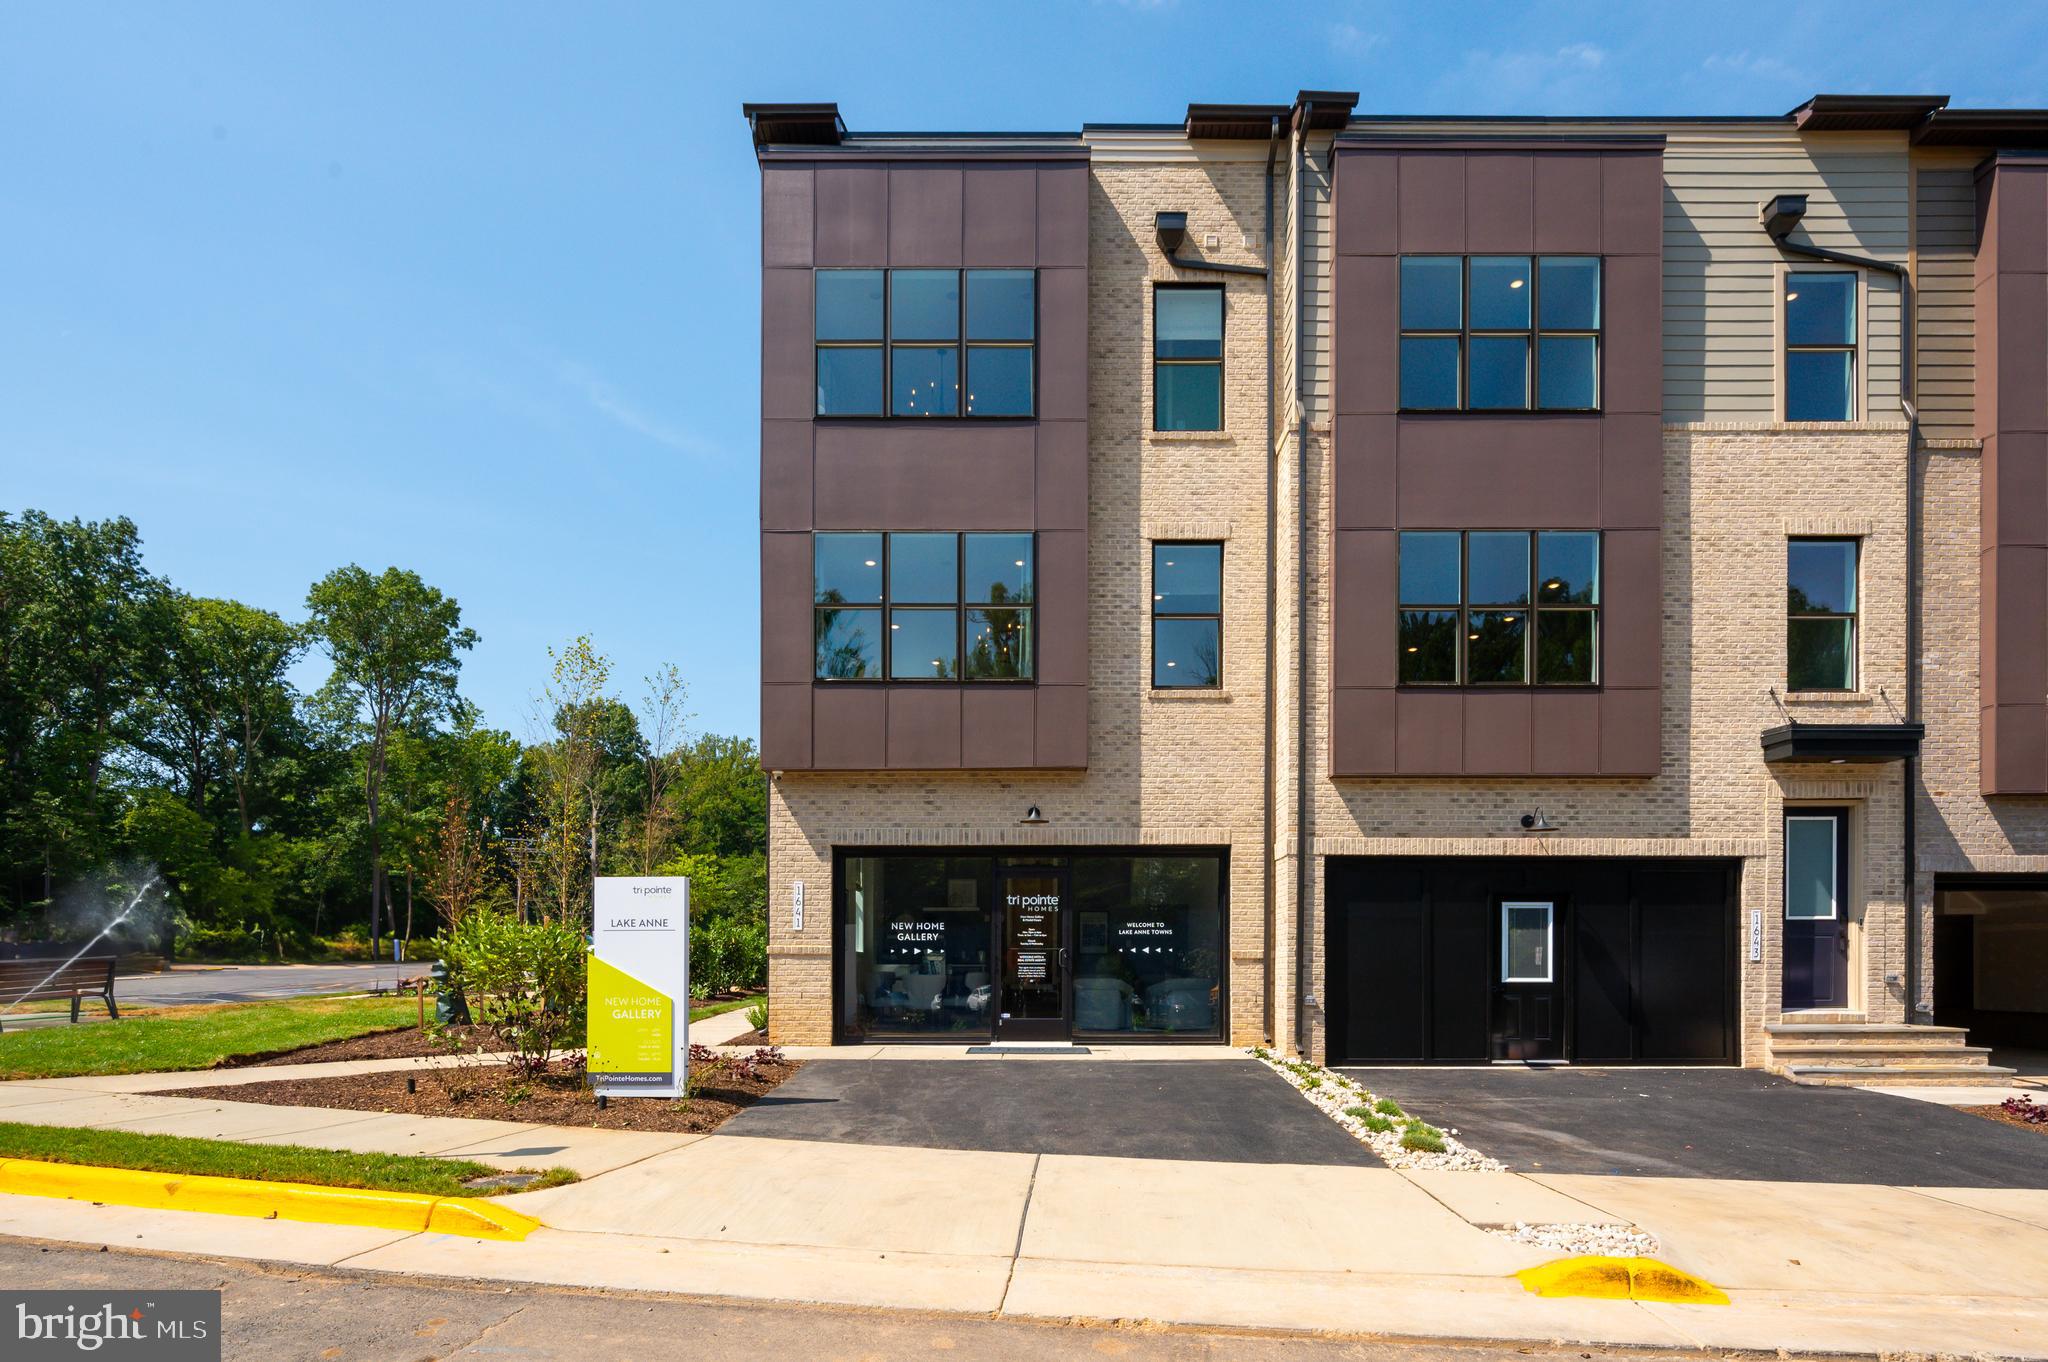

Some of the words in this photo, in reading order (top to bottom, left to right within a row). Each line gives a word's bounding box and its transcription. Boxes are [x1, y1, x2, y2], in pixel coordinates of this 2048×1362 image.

[633, 886, 642, 894] tri
[644, 886, 672, 896] pointe
[1006, 894, 1020, 905] tri
[1022, 894, 1059, 908] pointe
[611, 919, 636, 927] LAKE
[639, 919, 669, 927] ANNE
[891, 922, 914, 931] NEW
[916, 922, 945, 931] HOME
[897, 933, 939, 941] GALLERY
[605, 997, 629, 1006] NEW
[631, 997, 661, 1006] HOME
[612, 1009, 662, 1019] GALLERY
